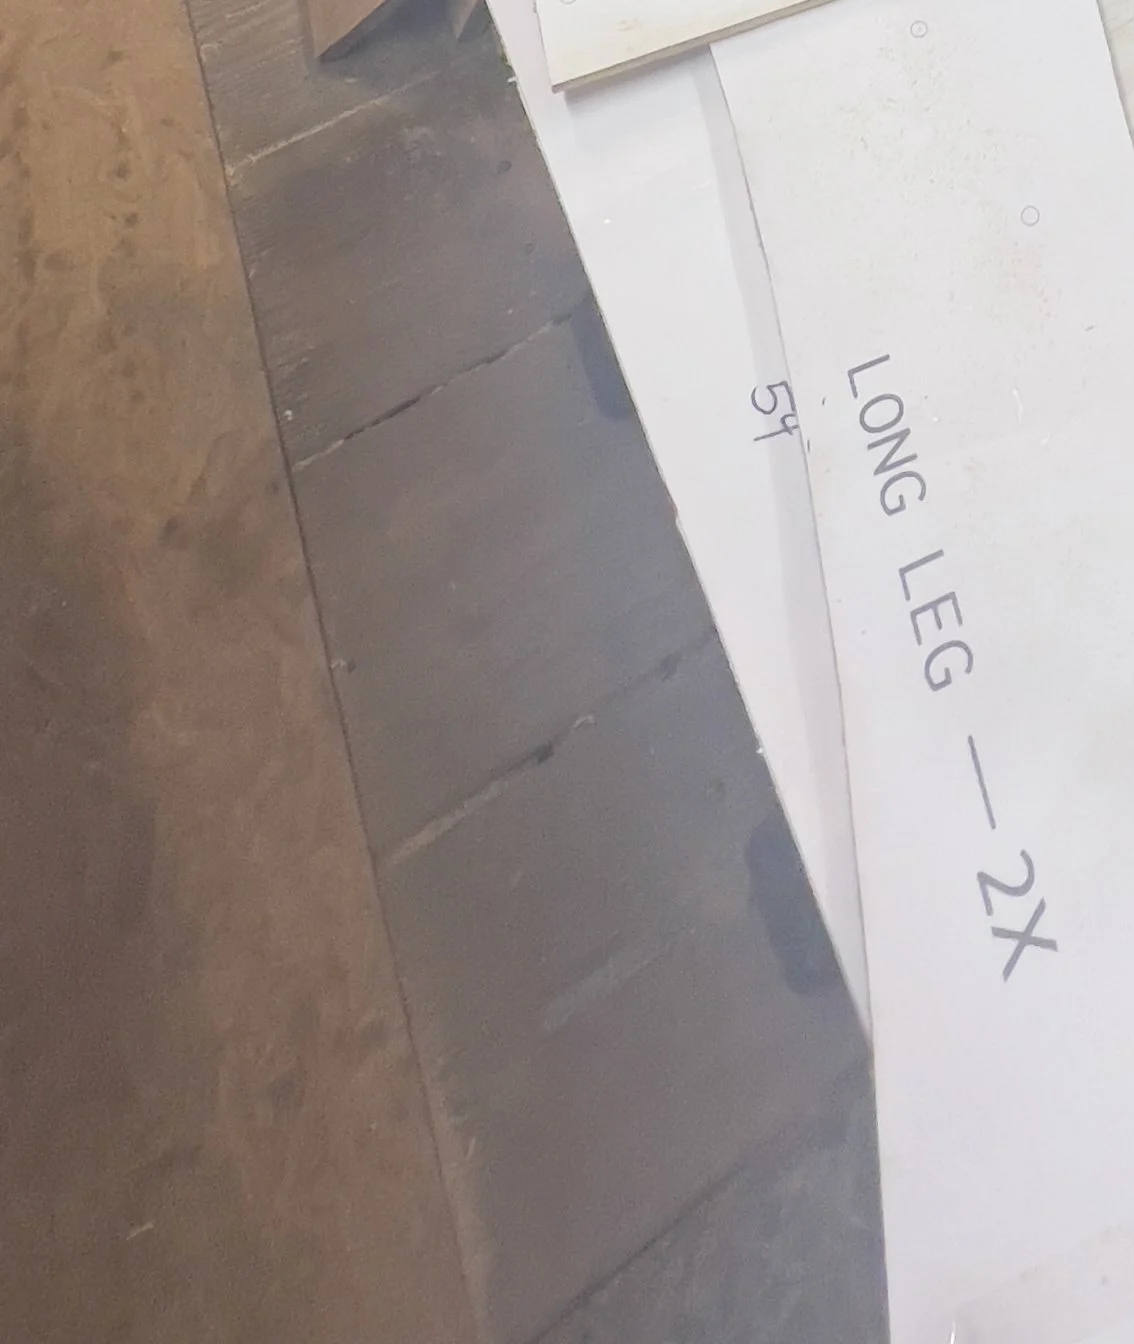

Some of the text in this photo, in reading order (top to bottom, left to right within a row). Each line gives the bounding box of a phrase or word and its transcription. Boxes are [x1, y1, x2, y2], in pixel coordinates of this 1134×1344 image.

[847, 353, 927, 518] LONG
[897, 549, 976, 693] LEG
[975, 848, 1059, 983] 2X
